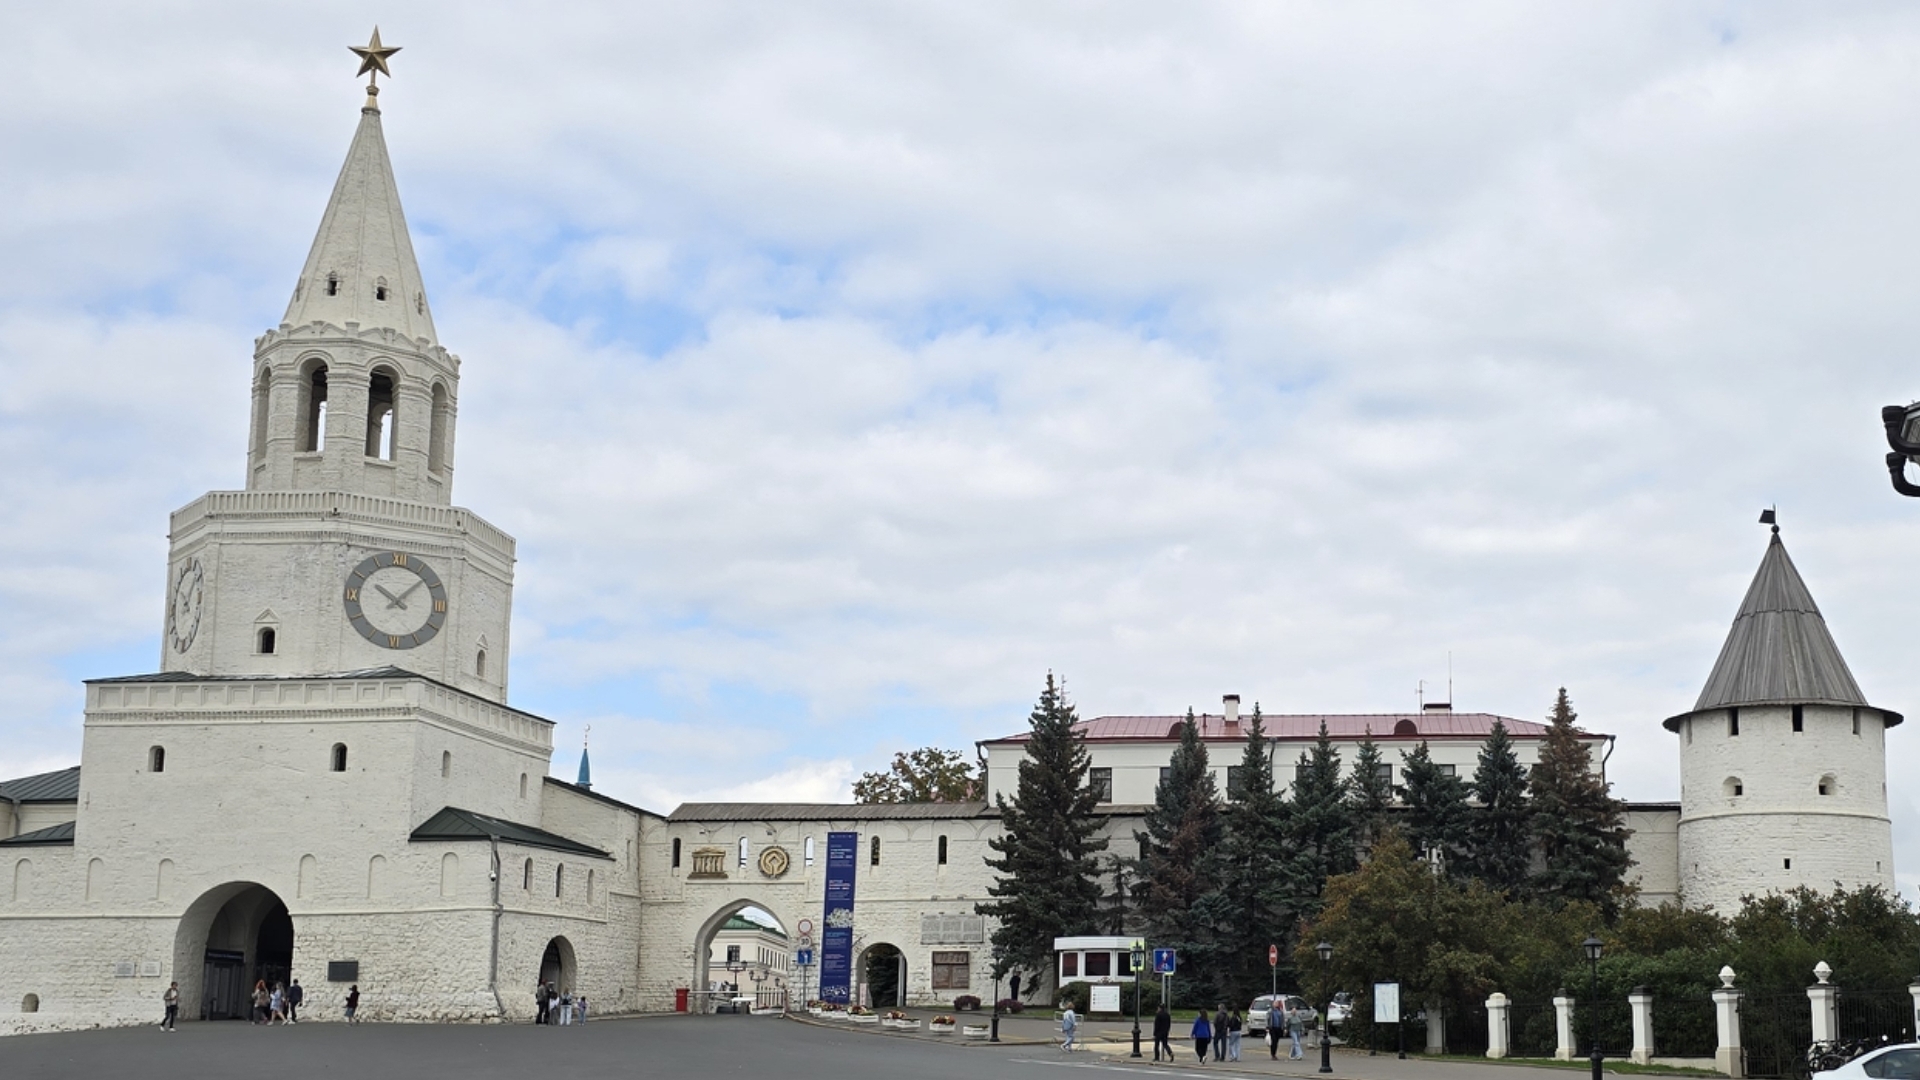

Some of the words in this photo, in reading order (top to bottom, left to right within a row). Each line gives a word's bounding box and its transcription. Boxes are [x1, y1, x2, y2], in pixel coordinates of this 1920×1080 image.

[392, 552, 407, 567] XII
[346, 588, 358, 601] IX
[434, 600, 446, 612] III
